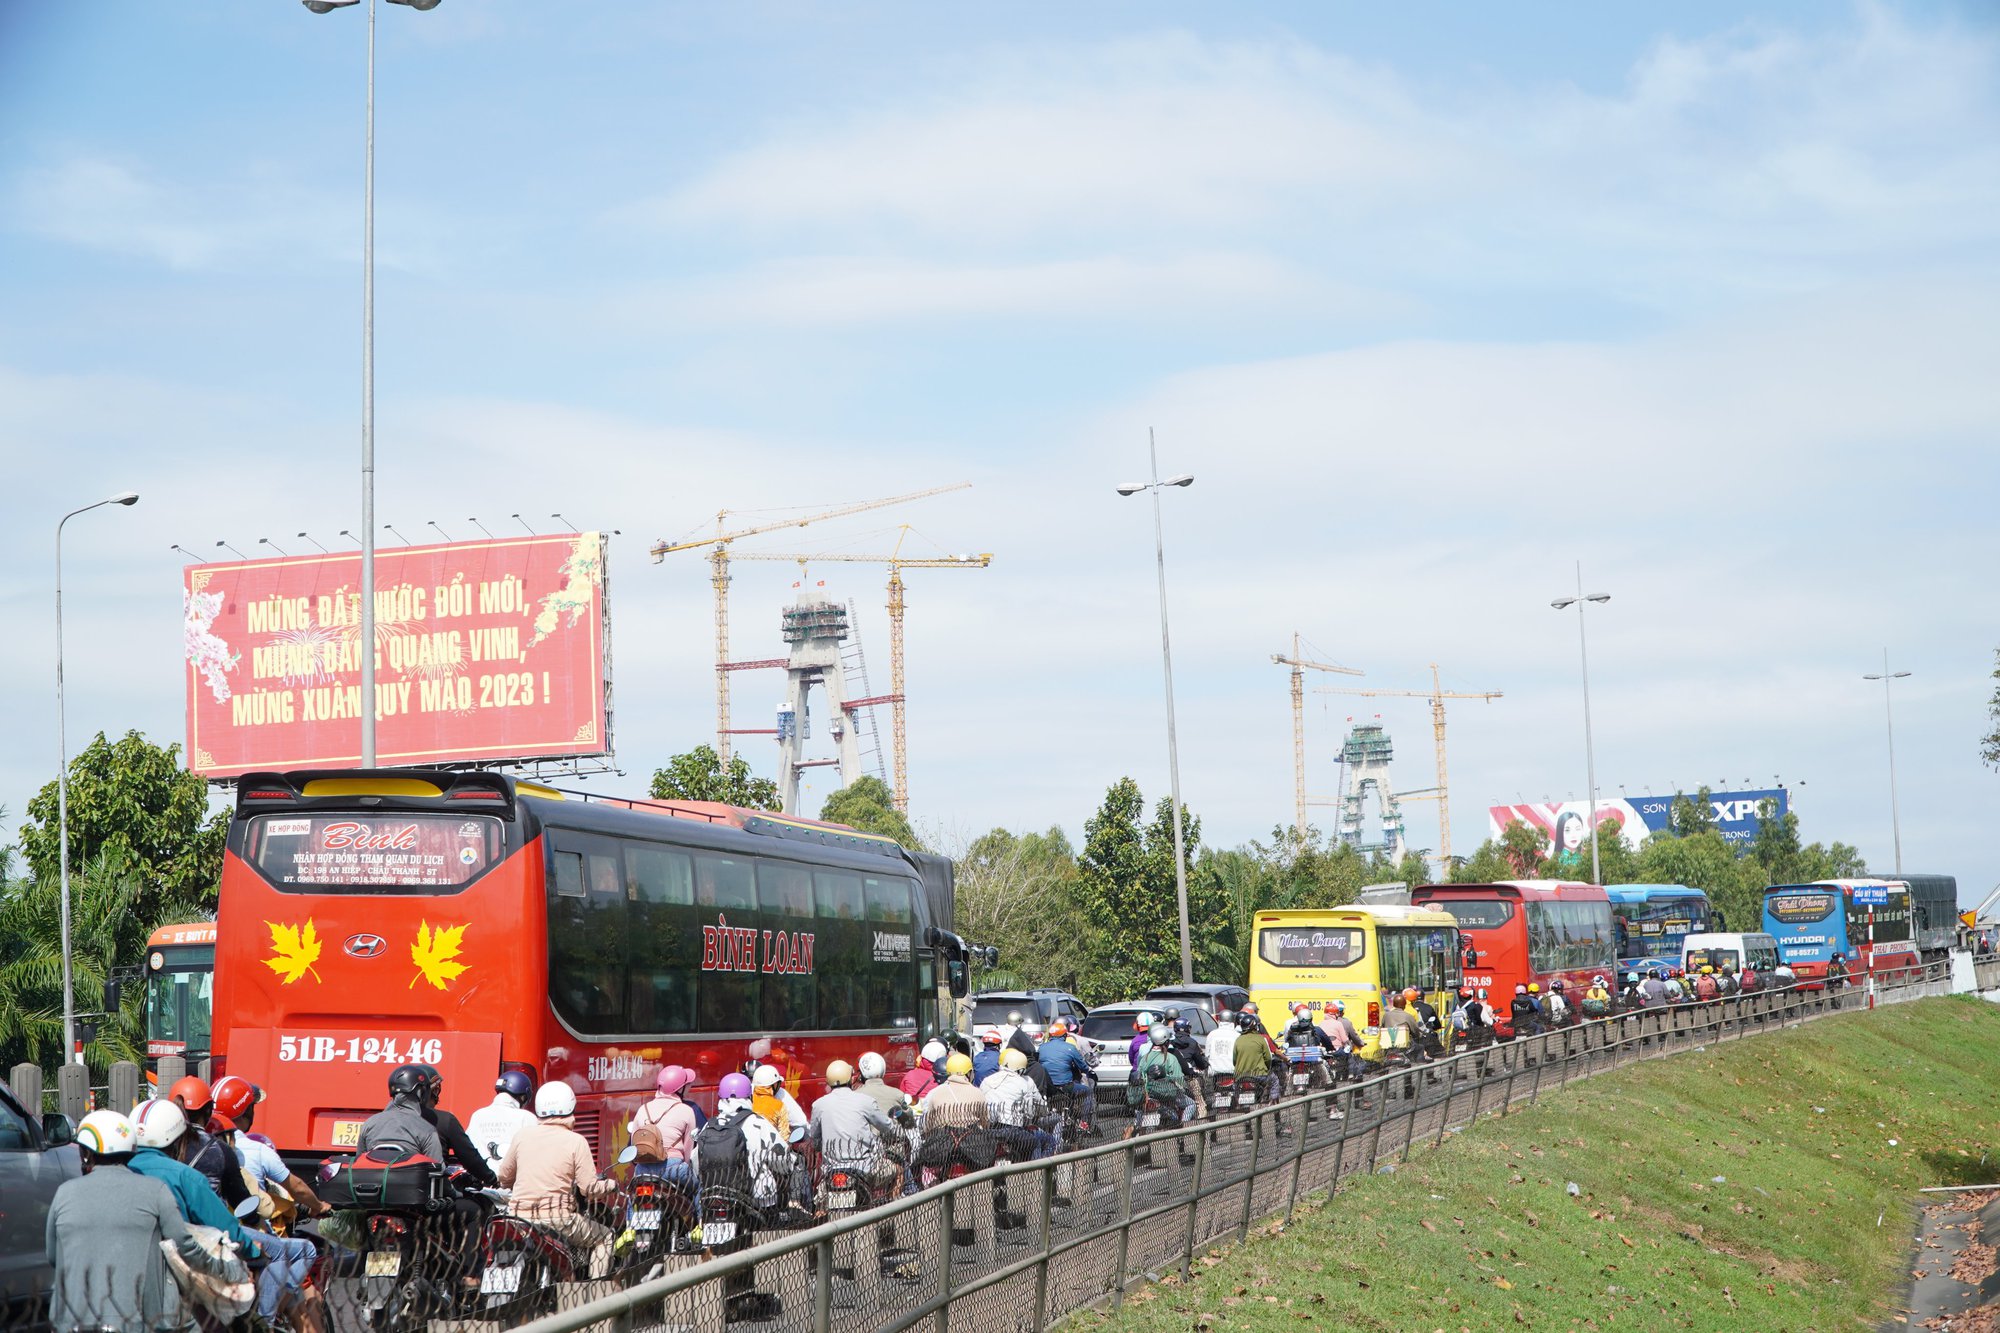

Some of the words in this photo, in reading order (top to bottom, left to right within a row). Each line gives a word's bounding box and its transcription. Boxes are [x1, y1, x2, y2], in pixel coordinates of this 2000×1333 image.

[247, 593, 309, 633] MỪNG
[318, 584, 361, 628] ĐẤT
[374, 582, 426, 624] NƯỚC
[434, 571, 472, 618] ĐỔI
[479, 573, 530, 617] MỚI,
[253, 639, 315, 679] MỪNG
[389, 630, 461, 673] QUANG
[468, 626, 526, 664] VINH,
[232, 686, 294, 726] MỪNG
[302, 680, 362, 722] XUÂN
[374, 675, 411, 721] QUÝ
[479, 672, 534, 708] 2023
[1643, 802, 1667, 814] SƠN
[268, 825, 276, 833] XE
[322, 821, 418, 850] Bình
[293, 851, 317, 866] NHẬN
[360, 853, 384, 865] THAM
[385, 854, 410, 866] QUAN
[410, 855, 421, 865] DU
[423, 855, 444, 867] LỊCH
[329, 866, 340, 874] AN
[367, 865, 390, 875] CHÂU
[391, 865, 420, 875] THÀNH
[426, 868, 438, 876] ST
[174, 932, 185, 943] XE
[701, 912, 758, 972] BÌNH
[762, 930, 815, 975] LOAN
[1780, 935, 1825, 944] HYUNDAI
[278, 1034, 443, 1065] 51B-124.46
[588, 1055, 643, 1081] 51B-124.46
